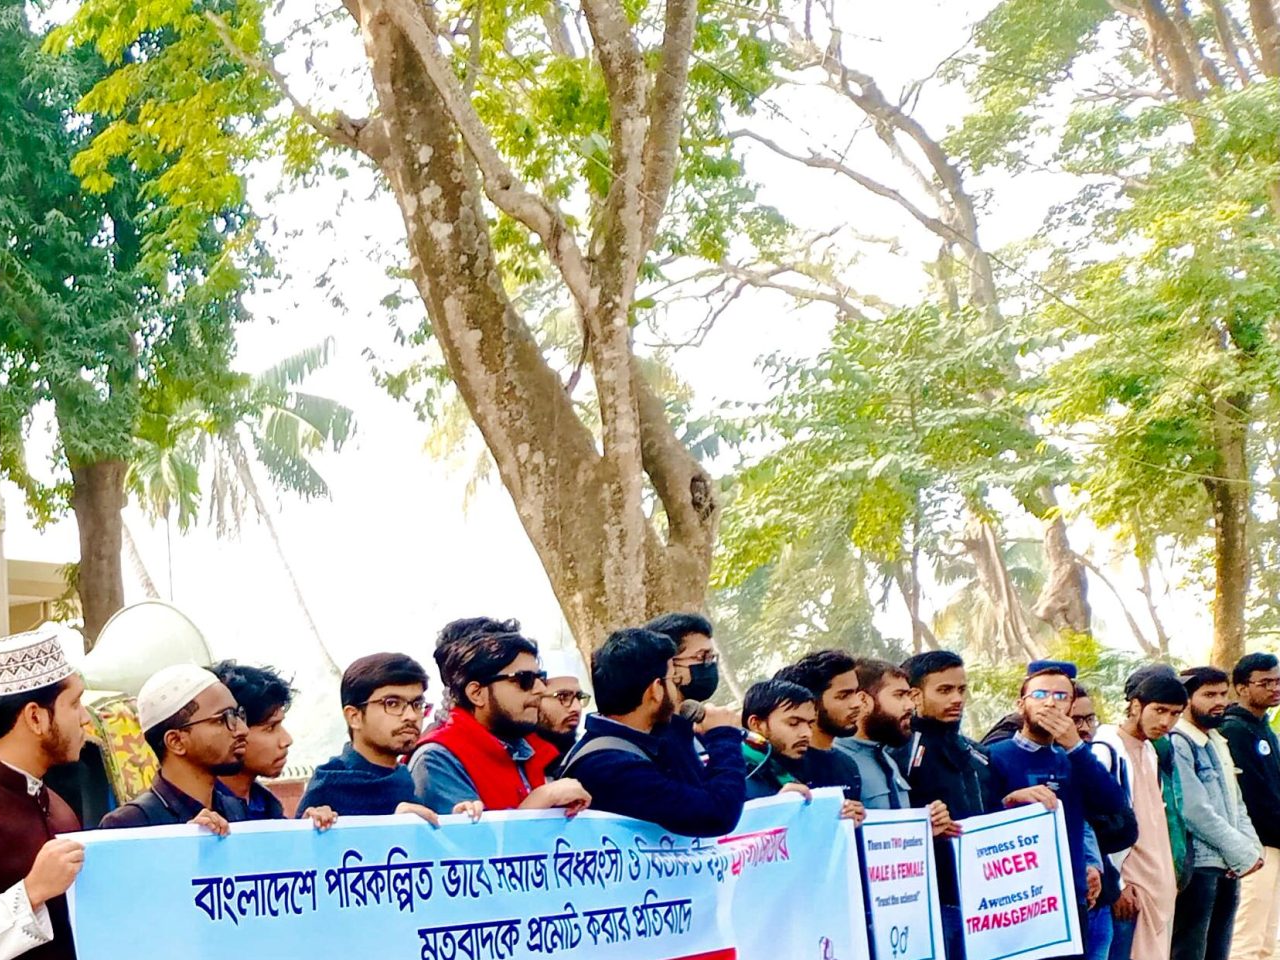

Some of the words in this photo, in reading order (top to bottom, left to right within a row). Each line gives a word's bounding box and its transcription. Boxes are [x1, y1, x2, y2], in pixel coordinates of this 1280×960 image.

[1017, 834, 1039, 847] for
[191, 869, 317, 926] বাংলাদেশে
[324, 847, 434, 913] পরিকল্পিত
[440, 859, 493, 899] ভাবে
[488, 854, 549, 893] সমাজ
[553, 835, 623, 889] বিধ্বংসী
[628, 848, 641, 881] ও
[897, 861, 924, 879] FEMALE
[1031, 885, 1043, 898] for
[526, 902, 582, 954] প্রমোট
[583, 907, 631, 945] করার
[632, 889, 692, 938] প্রতিবাদে
[966, 896, 1058, 935] TRANSGENDER
